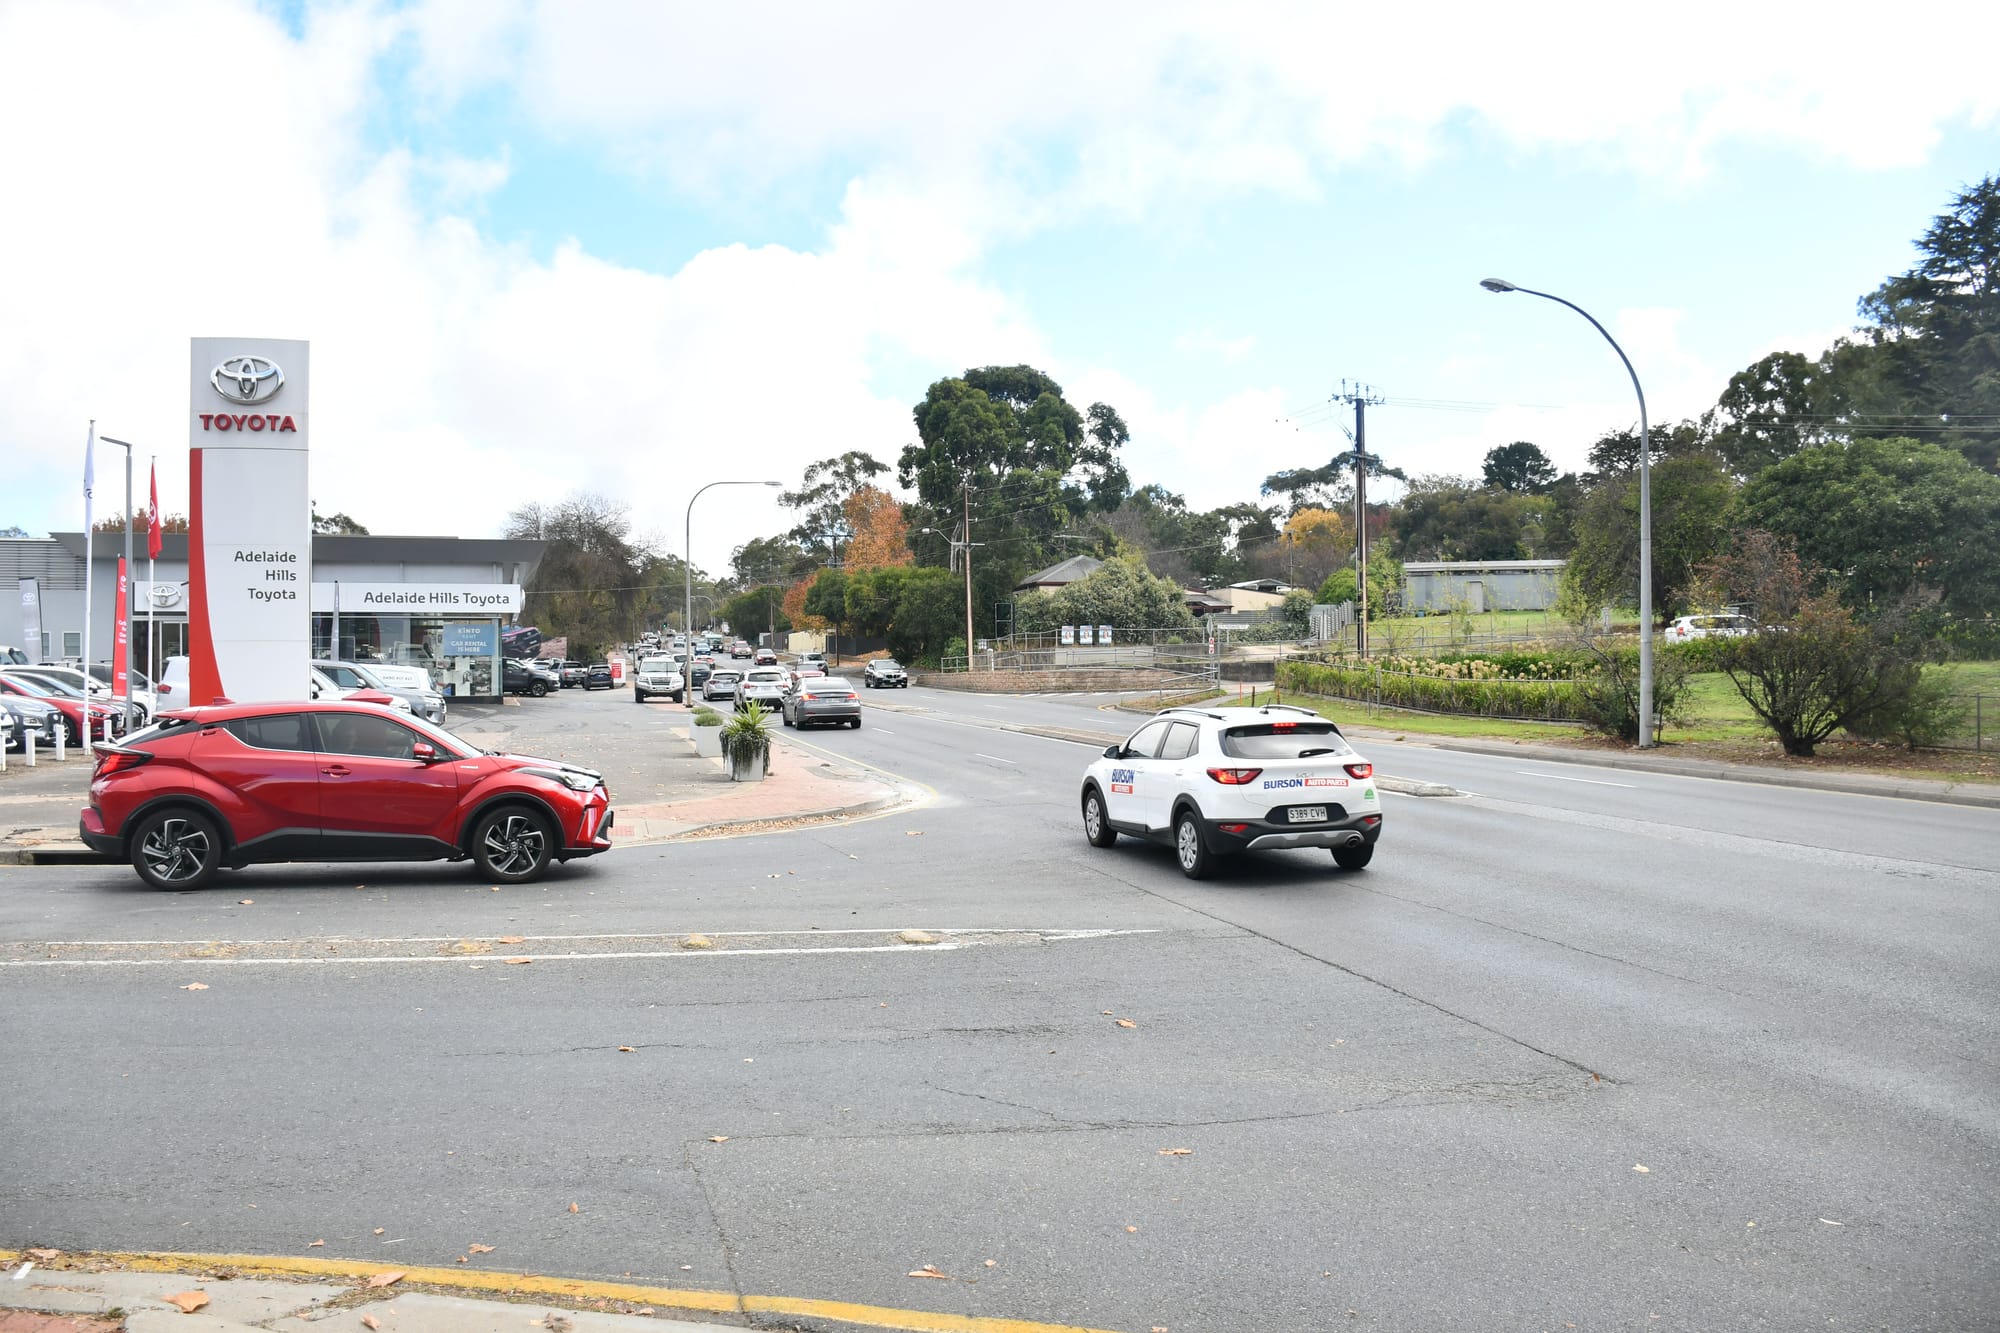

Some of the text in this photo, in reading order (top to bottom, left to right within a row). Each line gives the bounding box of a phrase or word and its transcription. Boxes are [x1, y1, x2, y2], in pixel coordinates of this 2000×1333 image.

[199, 413, 297, 433] TOYOTA
[234, 550, 297, 563] Adelaide
[265, 569, 297, 581] Hills
[247, 588, 296, 602] Toyota
[364, 591, 510, 607] Adelaide Hills Toyota
[1111, 769, 1135, 784] BURSON
[1264, 778, 1303, 789] BURSON
[1310, 808, 1326, 818] CVH
